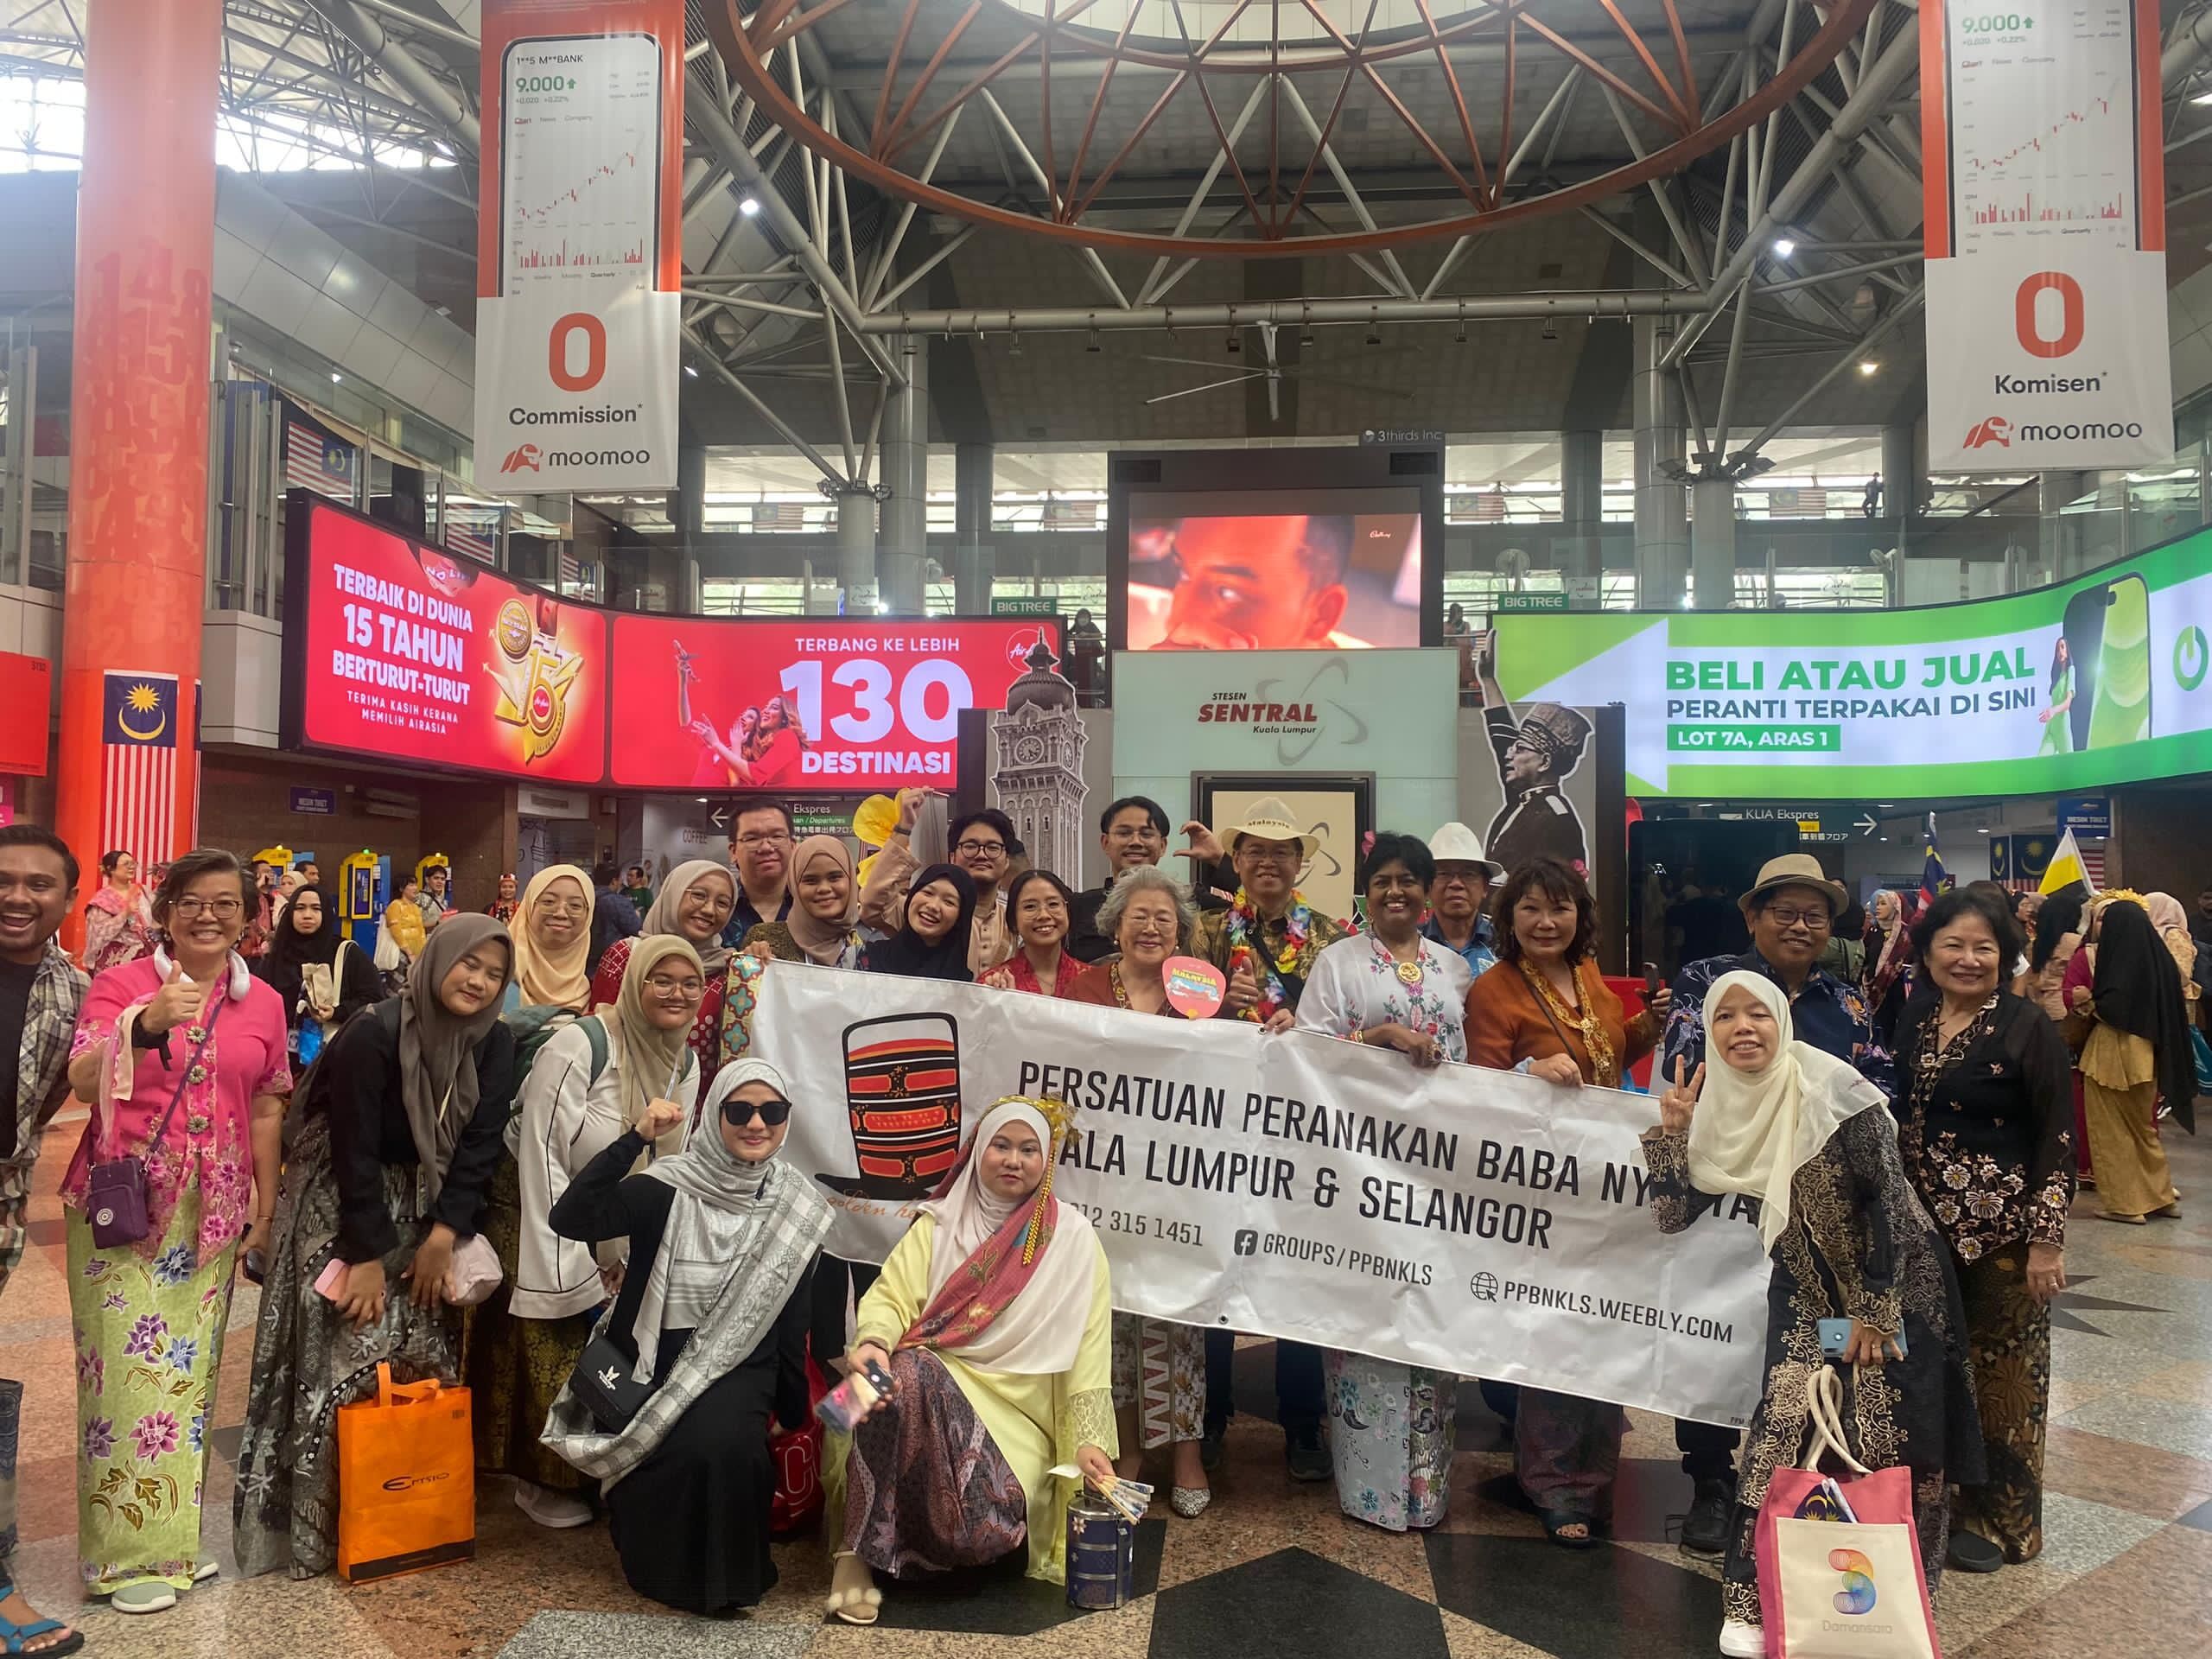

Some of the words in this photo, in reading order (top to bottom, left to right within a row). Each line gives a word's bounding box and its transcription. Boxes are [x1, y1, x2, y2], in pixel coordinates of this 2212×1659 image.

[1962, 14, 2020, 33] 9.000
[515, 76, 564, 92] 9.000
[2015, 270, 2084, 359] 0
[549, 312, 607, 392] 0
[1377, 429, 1420, 442] 3thirds
[2020, 423, 2143, 441] moomoo
[549, 449, 650, 467] moomoo
[334, 563, 405, 610] TERBAIK
[407, 589, 424, 617] DI
[427, 595, 474, 632] DUNIA
[996, 601, 1018, 613] BIG
[1020, 601, 1052, 613] TREE
[1504, 596, 1527, 607] BIG
[1528, 596, 1563, 607] TREE
[343, 603, 373, 647] 15
[378, 613, 464, 672] TAHUN
[795, 638, 878, 652] TERBANG
[883, 638, 905, 652] KE
[910, 638, 960, 652] LEBIH
[333, 649, 471, 706] BERTURUT-TURUT
[1666, 660, 1764, 690] BELI
[1777, 659, 1906, 690] ATAU
[1921, 647, 2036, 688] JUAL
[779, 658, 974, 743] 130
[1212, 692, 1247, 701] STESEN
[1667, 699, 1787, 719] PERANTI
[1795, 696, 1940, 719] TERPAKAI
[1950, 694, 1980, 715] DI
[1988, 687, 2036, 711] SINI
[347, 690, 386, 709] TERIMA
[390, 700, 419, 715] KASIH
[423, 707, 459, 723] KERANA
[1198, 703, 1318, 722] SENTRAL
[361, 709, 405, 727] MEMILIH
[409, 718, 447, 734] AIRASIA
[1282, 726, 1317, 735] Lumpur
[1678, 732, 1717, 747] LOT
[1721, 732, 1754, 748] 7A,
[1758, 732, 1815, 747] ARAS
[1819, 732, 1828, 746] 1
[802, 751, 950, 774] DESTINASI
[793, 804, 831, 816] Ekspres
[1745, 809, 1774, 819] KLIA
[1777, 809, 1820, 822] Ekspres
[683, 830, 708, 844] COFFEE
[1018, 1061, 1225, 1128] PERSATUAN
[1243, 1092, 1459, 1172] PERANAKAN
[1476, 1140, 1580, 1197] BABA
[1059, 1130, 1126, 1176] ALA
[1146, 1141, 1295, 1200] LUMPUR
[1313, 1167, 1340, 1208] &
[1359, 1176, 1553, 1249] SELANGOR
[1110, 1211, 1147, 1236] 315
[1154, 1218, 1203, 1247] 1451
[1503, 1281, 1732, 1344] PPBNKLS.WEEBLY.COM
[1822, 1620, 1893, 1635] Damansara
